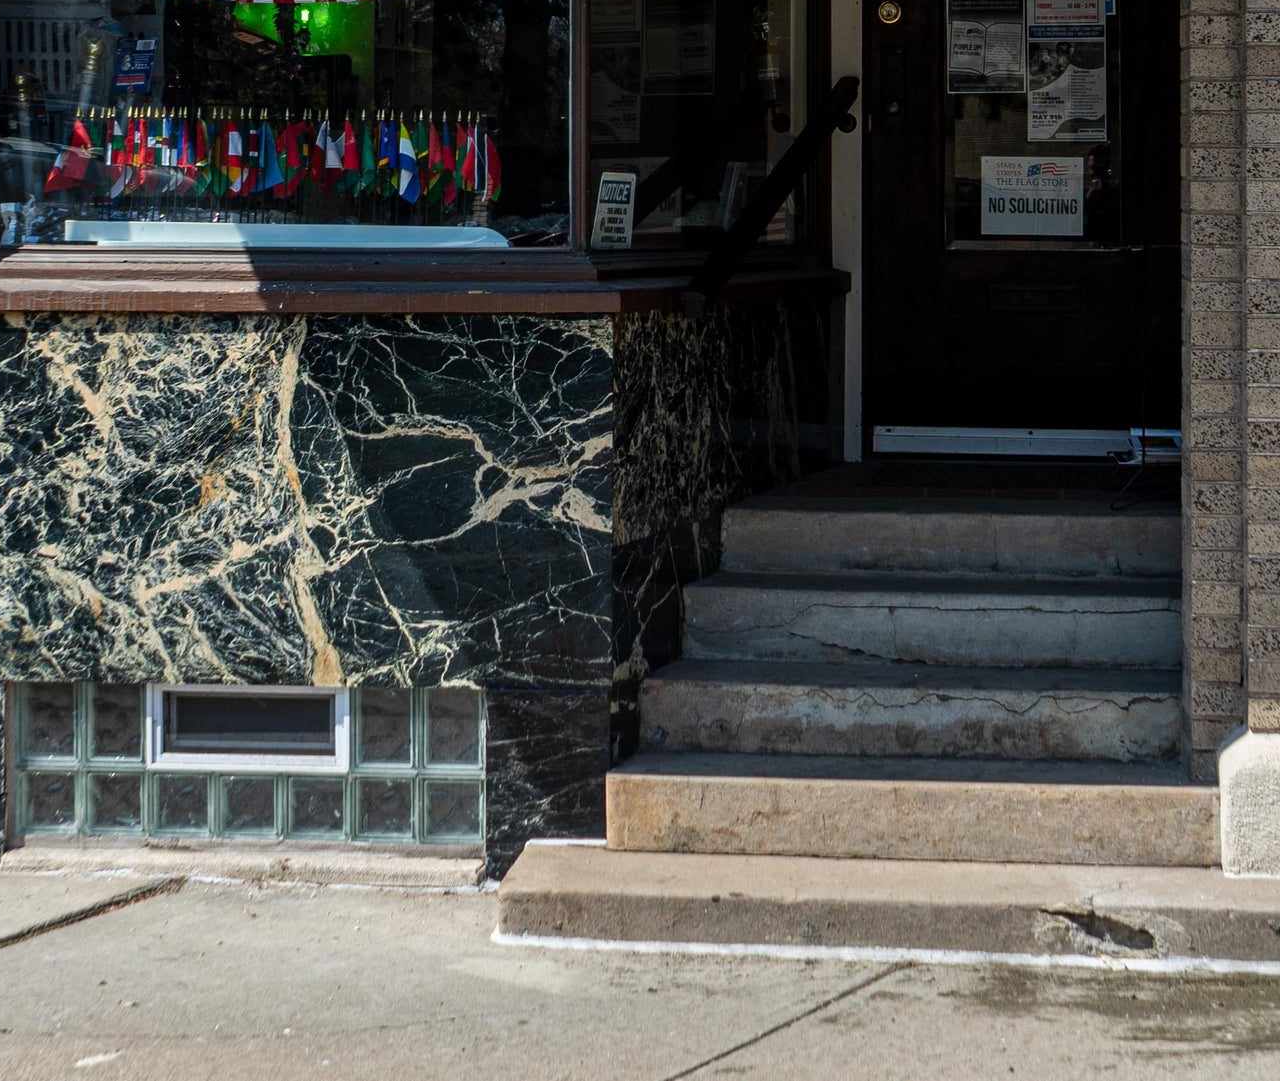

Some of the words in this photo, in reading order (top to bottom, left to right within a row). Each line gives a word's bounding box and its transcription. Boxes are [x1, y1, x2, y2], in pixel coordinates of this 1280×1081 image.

[996, 178, 1013, 186] THE
[1016, 178, 1039, 186] FLAG
[1041, 178, 1069, 187] STORE
[601, 183, 630, 201] NOTICE
[989, 198, 1005, 213] NO
[1009, 198, 1078, 215] SOLICITING
